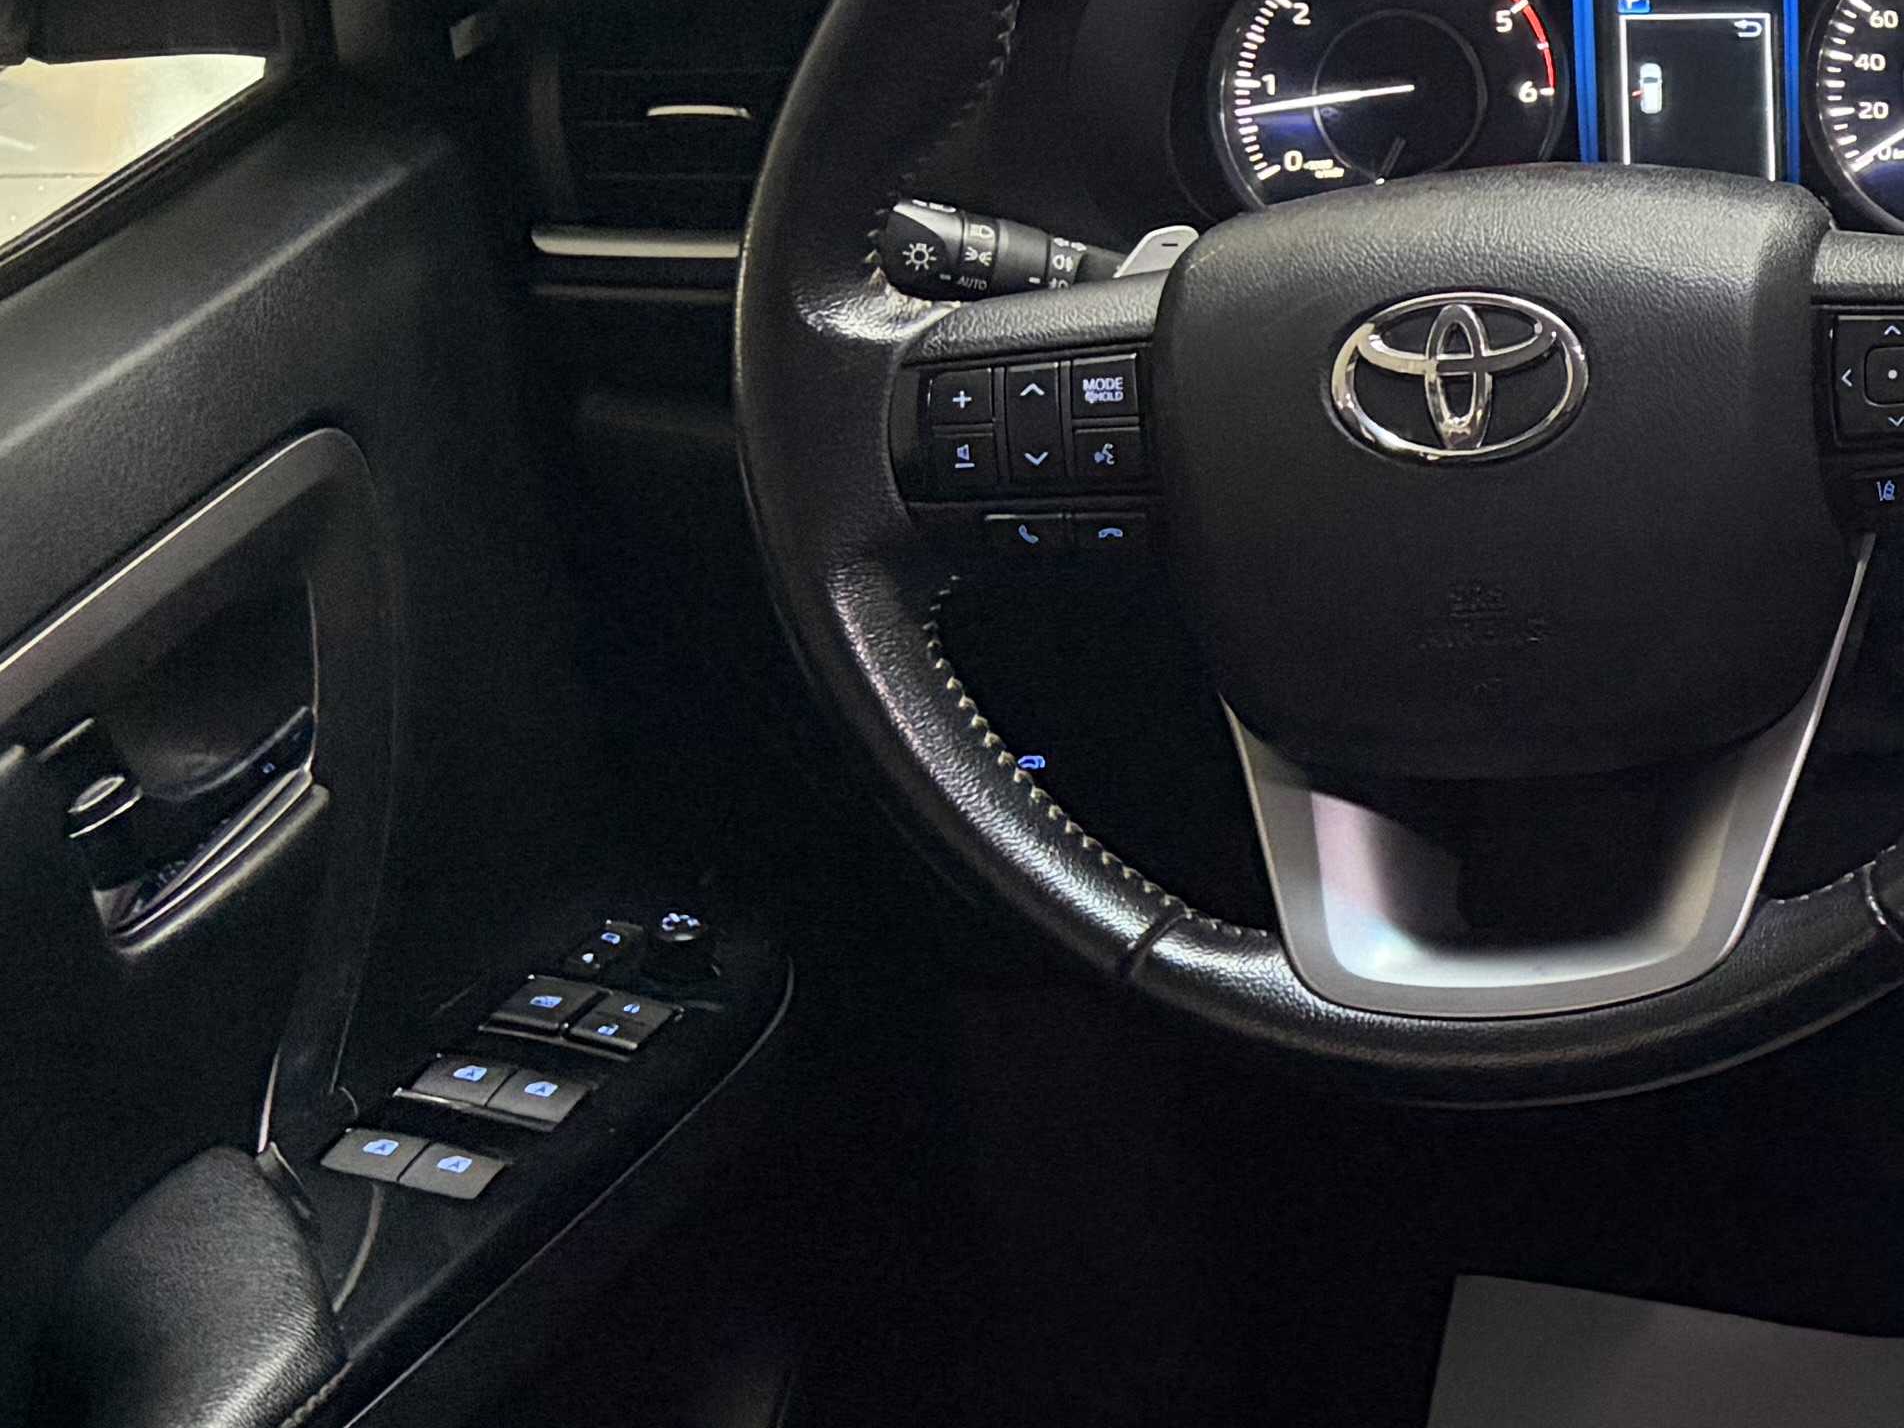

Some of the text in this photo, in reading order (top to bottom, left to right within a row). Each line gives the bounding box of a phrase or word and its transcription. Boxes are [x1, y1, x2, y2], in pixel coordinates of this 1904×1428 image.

[1292, 4, 1311, 26] 2
[1495, 11, 1513, 32] 5
[1869, 10, 1898, 28] 60
[1855, 54, 1886, 71] 40
[1262, 74, 1276, 95] 1
[1519, 81, 1539, 102] 6
[1858, 102, 1889, 119] 20
[1283, 150, 1303, 171] 0
[957, 274, 987, 290] AUTO
[1083, 376, 1124, 392] MODE
